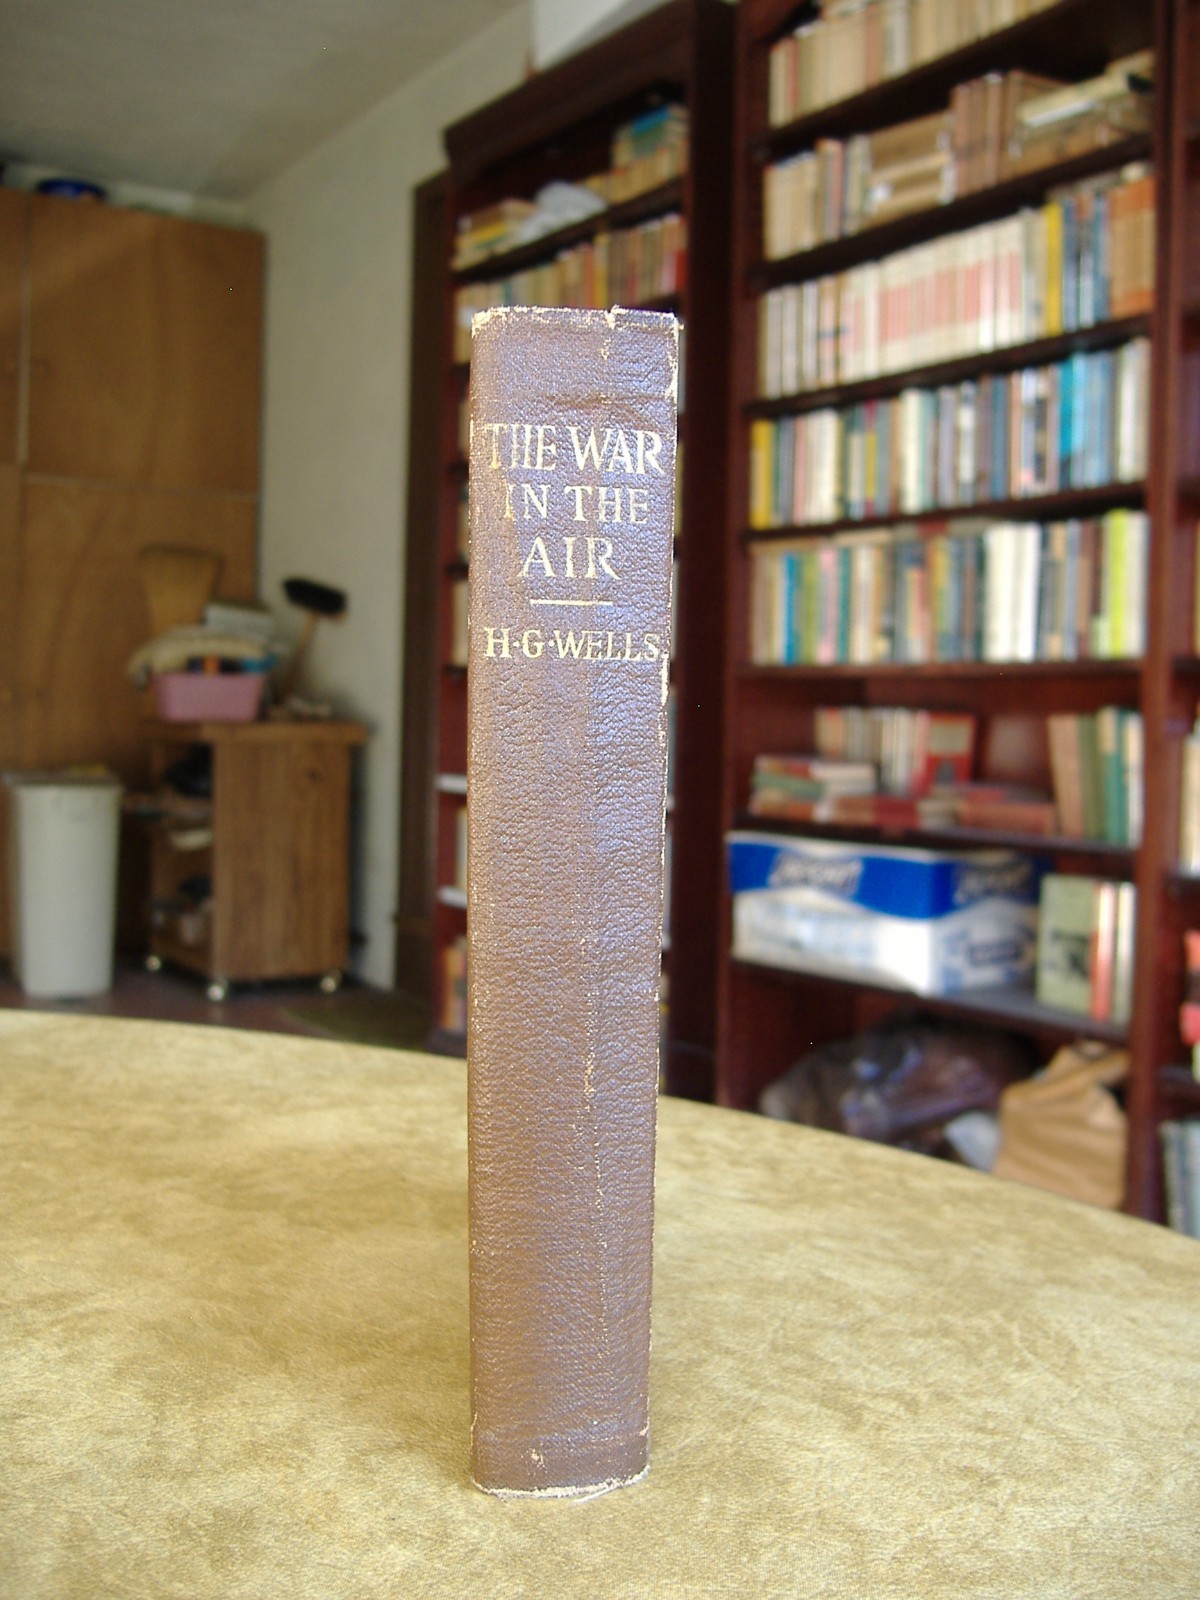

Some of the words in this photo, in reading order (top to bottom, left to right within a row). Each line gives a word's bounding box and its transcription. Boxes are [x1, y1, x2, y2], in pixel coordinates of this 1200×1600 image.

[484, 423, 556, 471] THE
[569, 427, 665, 475] WAR
[505, 485, 551, 521] IN
[565, 486, 648, 524] THE
[519, 537, 620, 580] AIR
